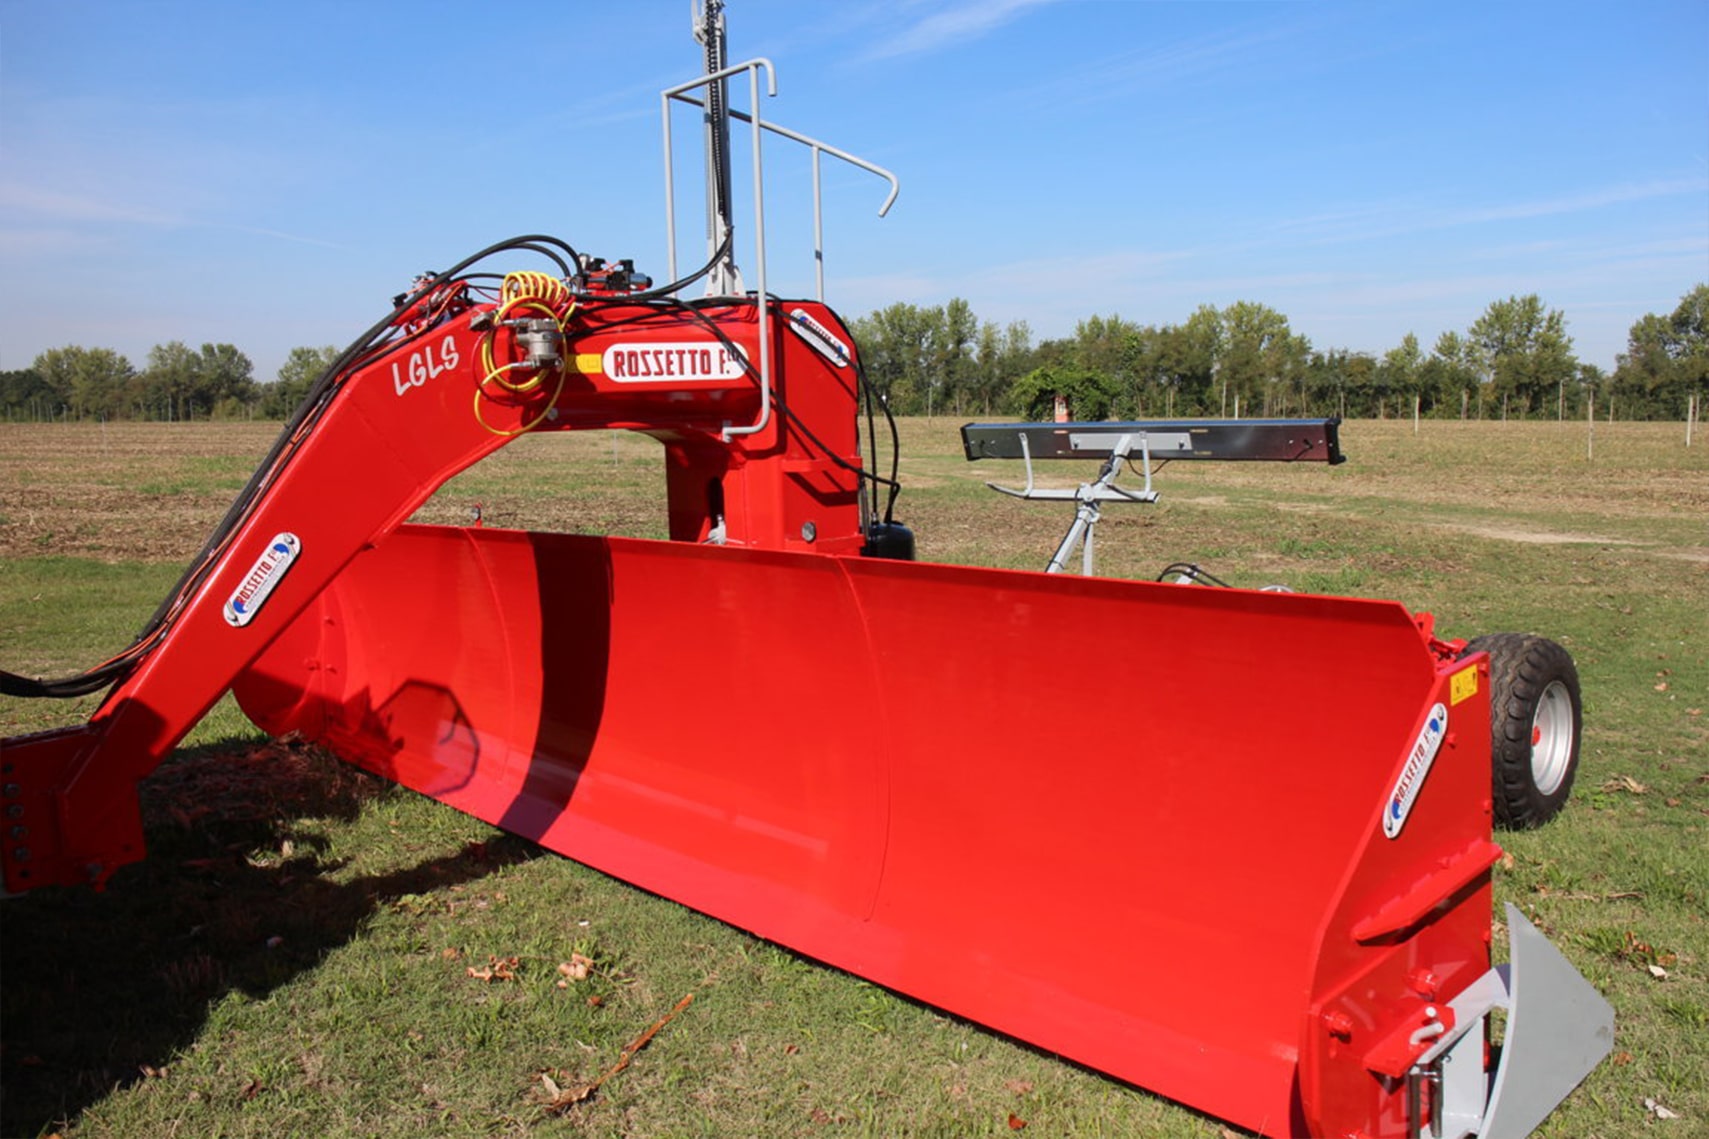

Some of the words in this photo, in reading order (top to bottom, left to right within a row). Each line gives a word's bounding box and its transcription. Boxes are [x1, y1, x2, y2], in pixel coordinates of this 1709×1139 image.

[392, 335, 459, 396] LGLS
[613, 349, 711, 377] ROSSETTO
[235, 561, 272, 605] ROSSETTO
[1393, 743, 1425, 804] ROSSETTO
